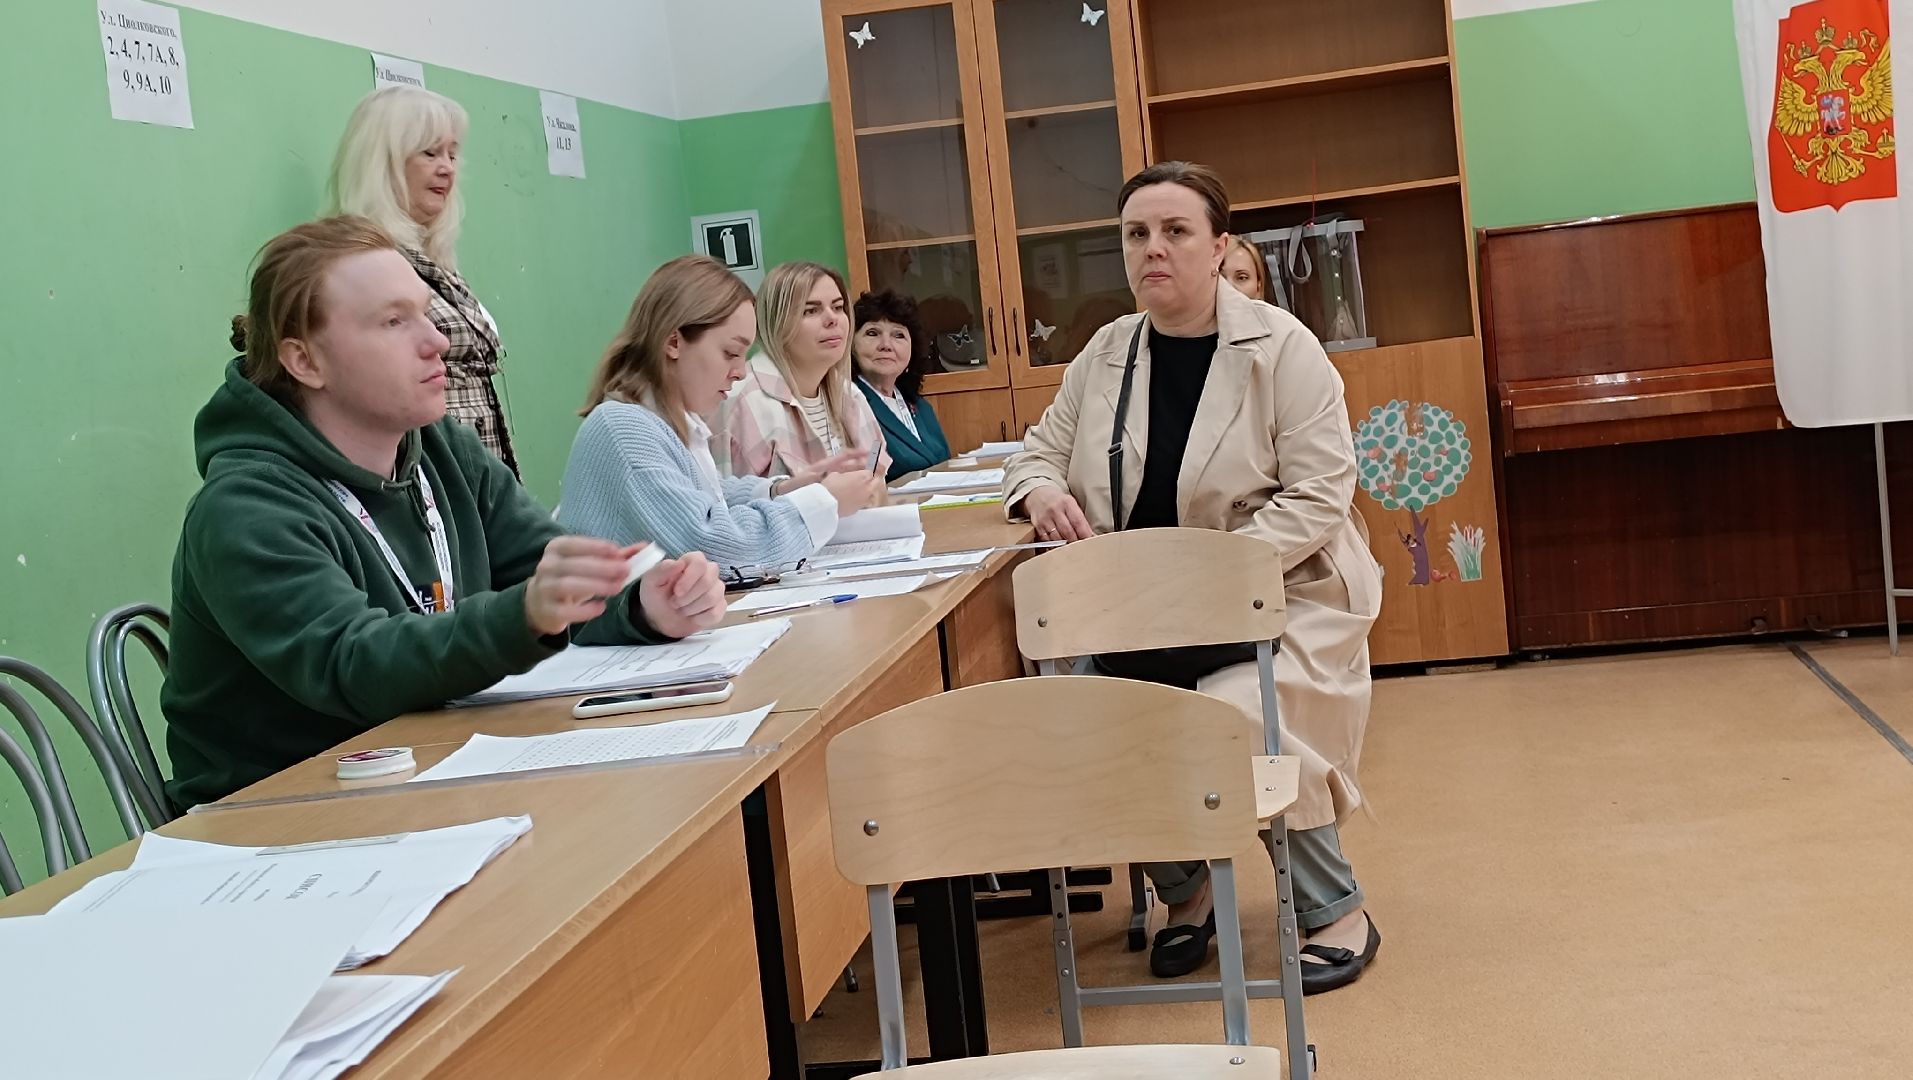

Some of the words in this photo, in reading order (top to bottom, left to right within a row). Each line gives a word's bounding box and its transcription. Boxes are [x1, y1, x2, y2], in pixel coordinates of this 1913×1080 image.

[100, 9, 116, 27] Ул.
[107, 35, 119, 60] 2,
[120, 38, 132, 62] 4,
[134, 40, 145, 64] 7,
[168, 45, 180, 71] 8,
[123, 68, 136, 93] 9,
[159, 74, 172, 96] 10
